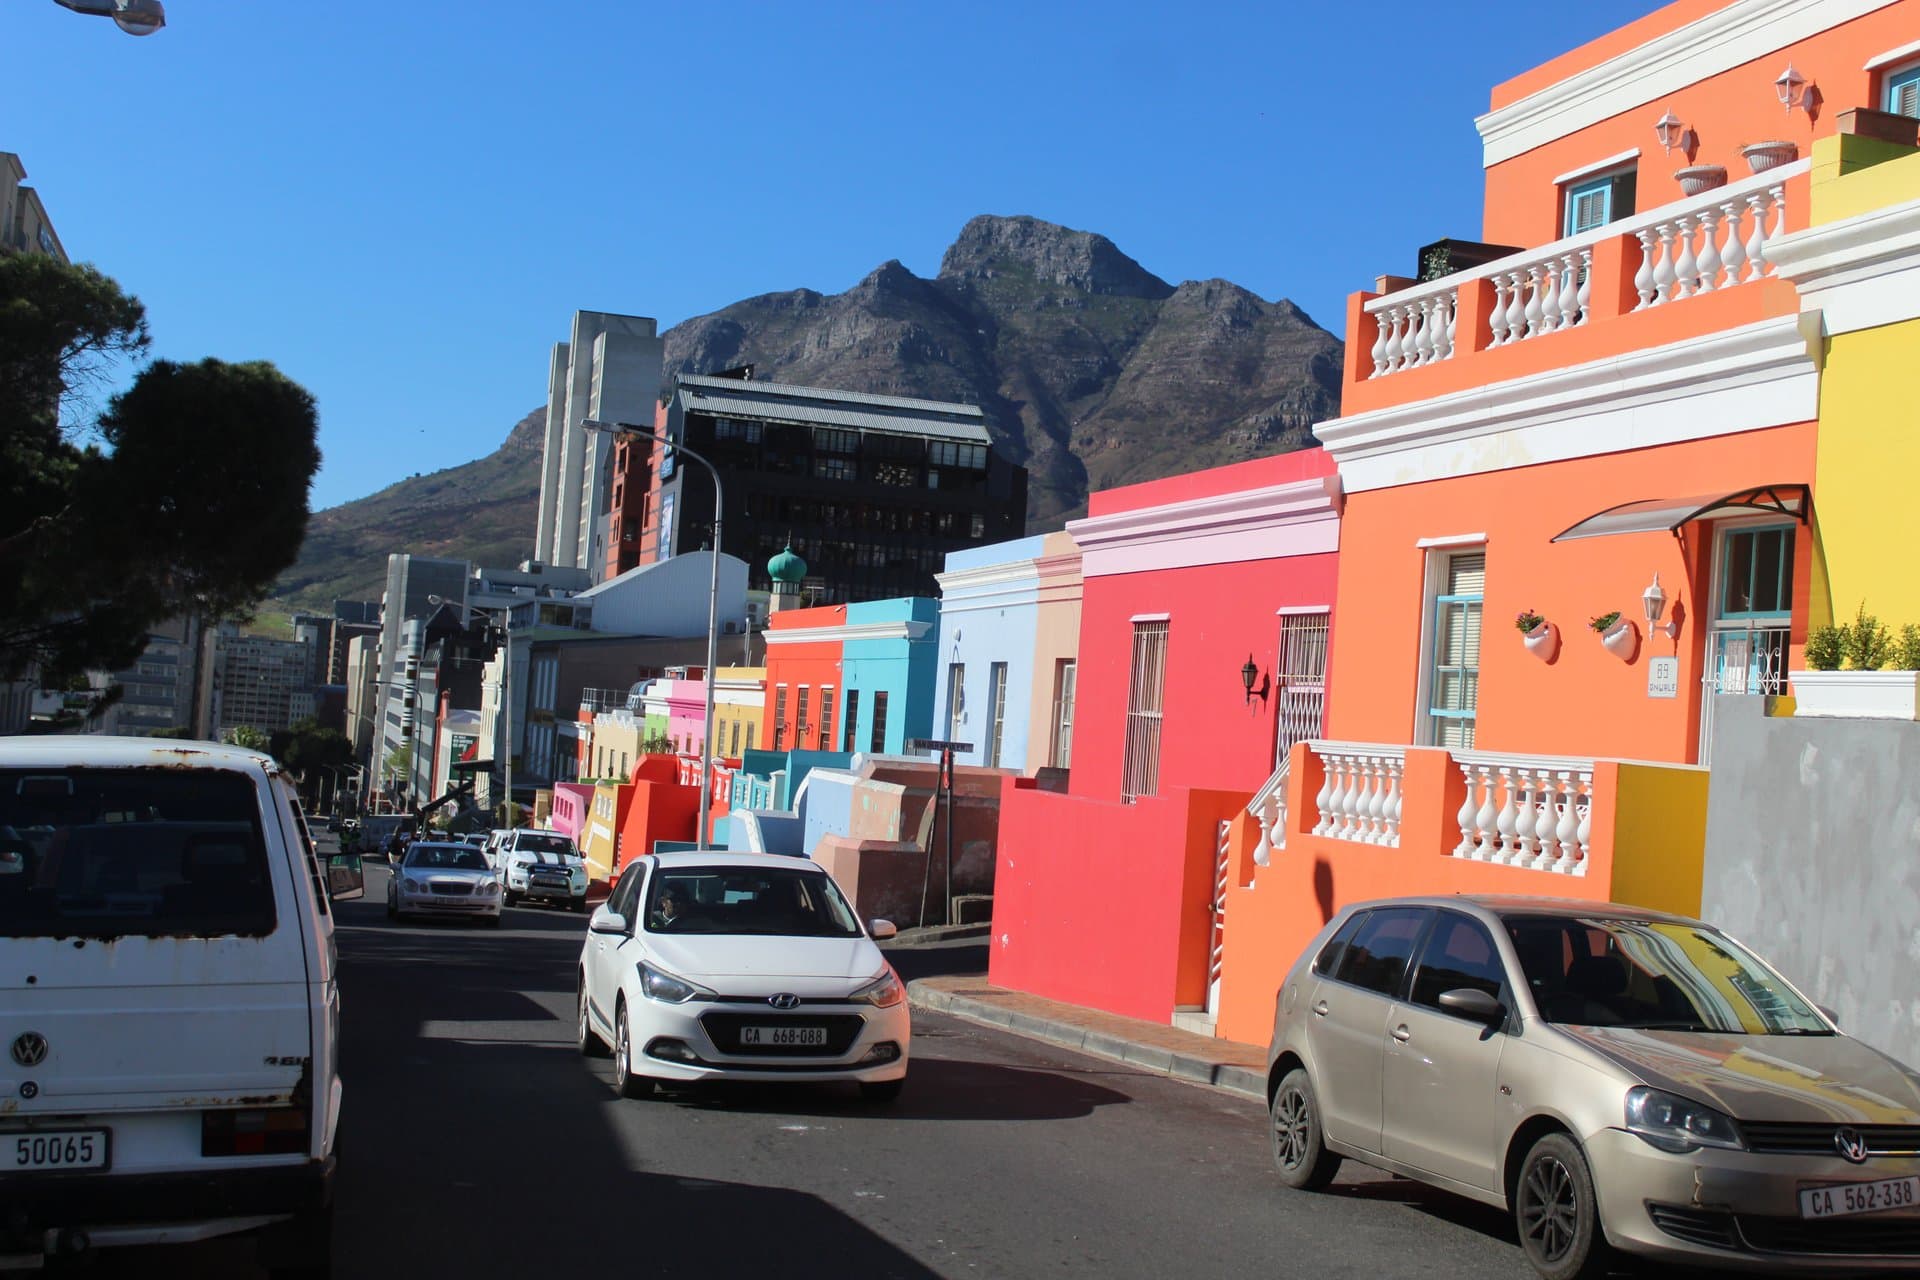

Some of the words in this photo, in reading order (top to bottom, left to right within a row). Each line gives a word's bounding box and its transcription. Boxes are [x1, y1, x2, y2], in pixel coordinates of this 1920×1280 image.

[1657, 663, 1669, 679] 89
[745, 1028, 760, 1043] CA
[773, 1029, 823, 1044] 668-088
[17, 1136, 93, 1165] 50065
[1811, 1191, 1834, 1214] CA
[1845, 1181, 1912, 1211] 562-338
